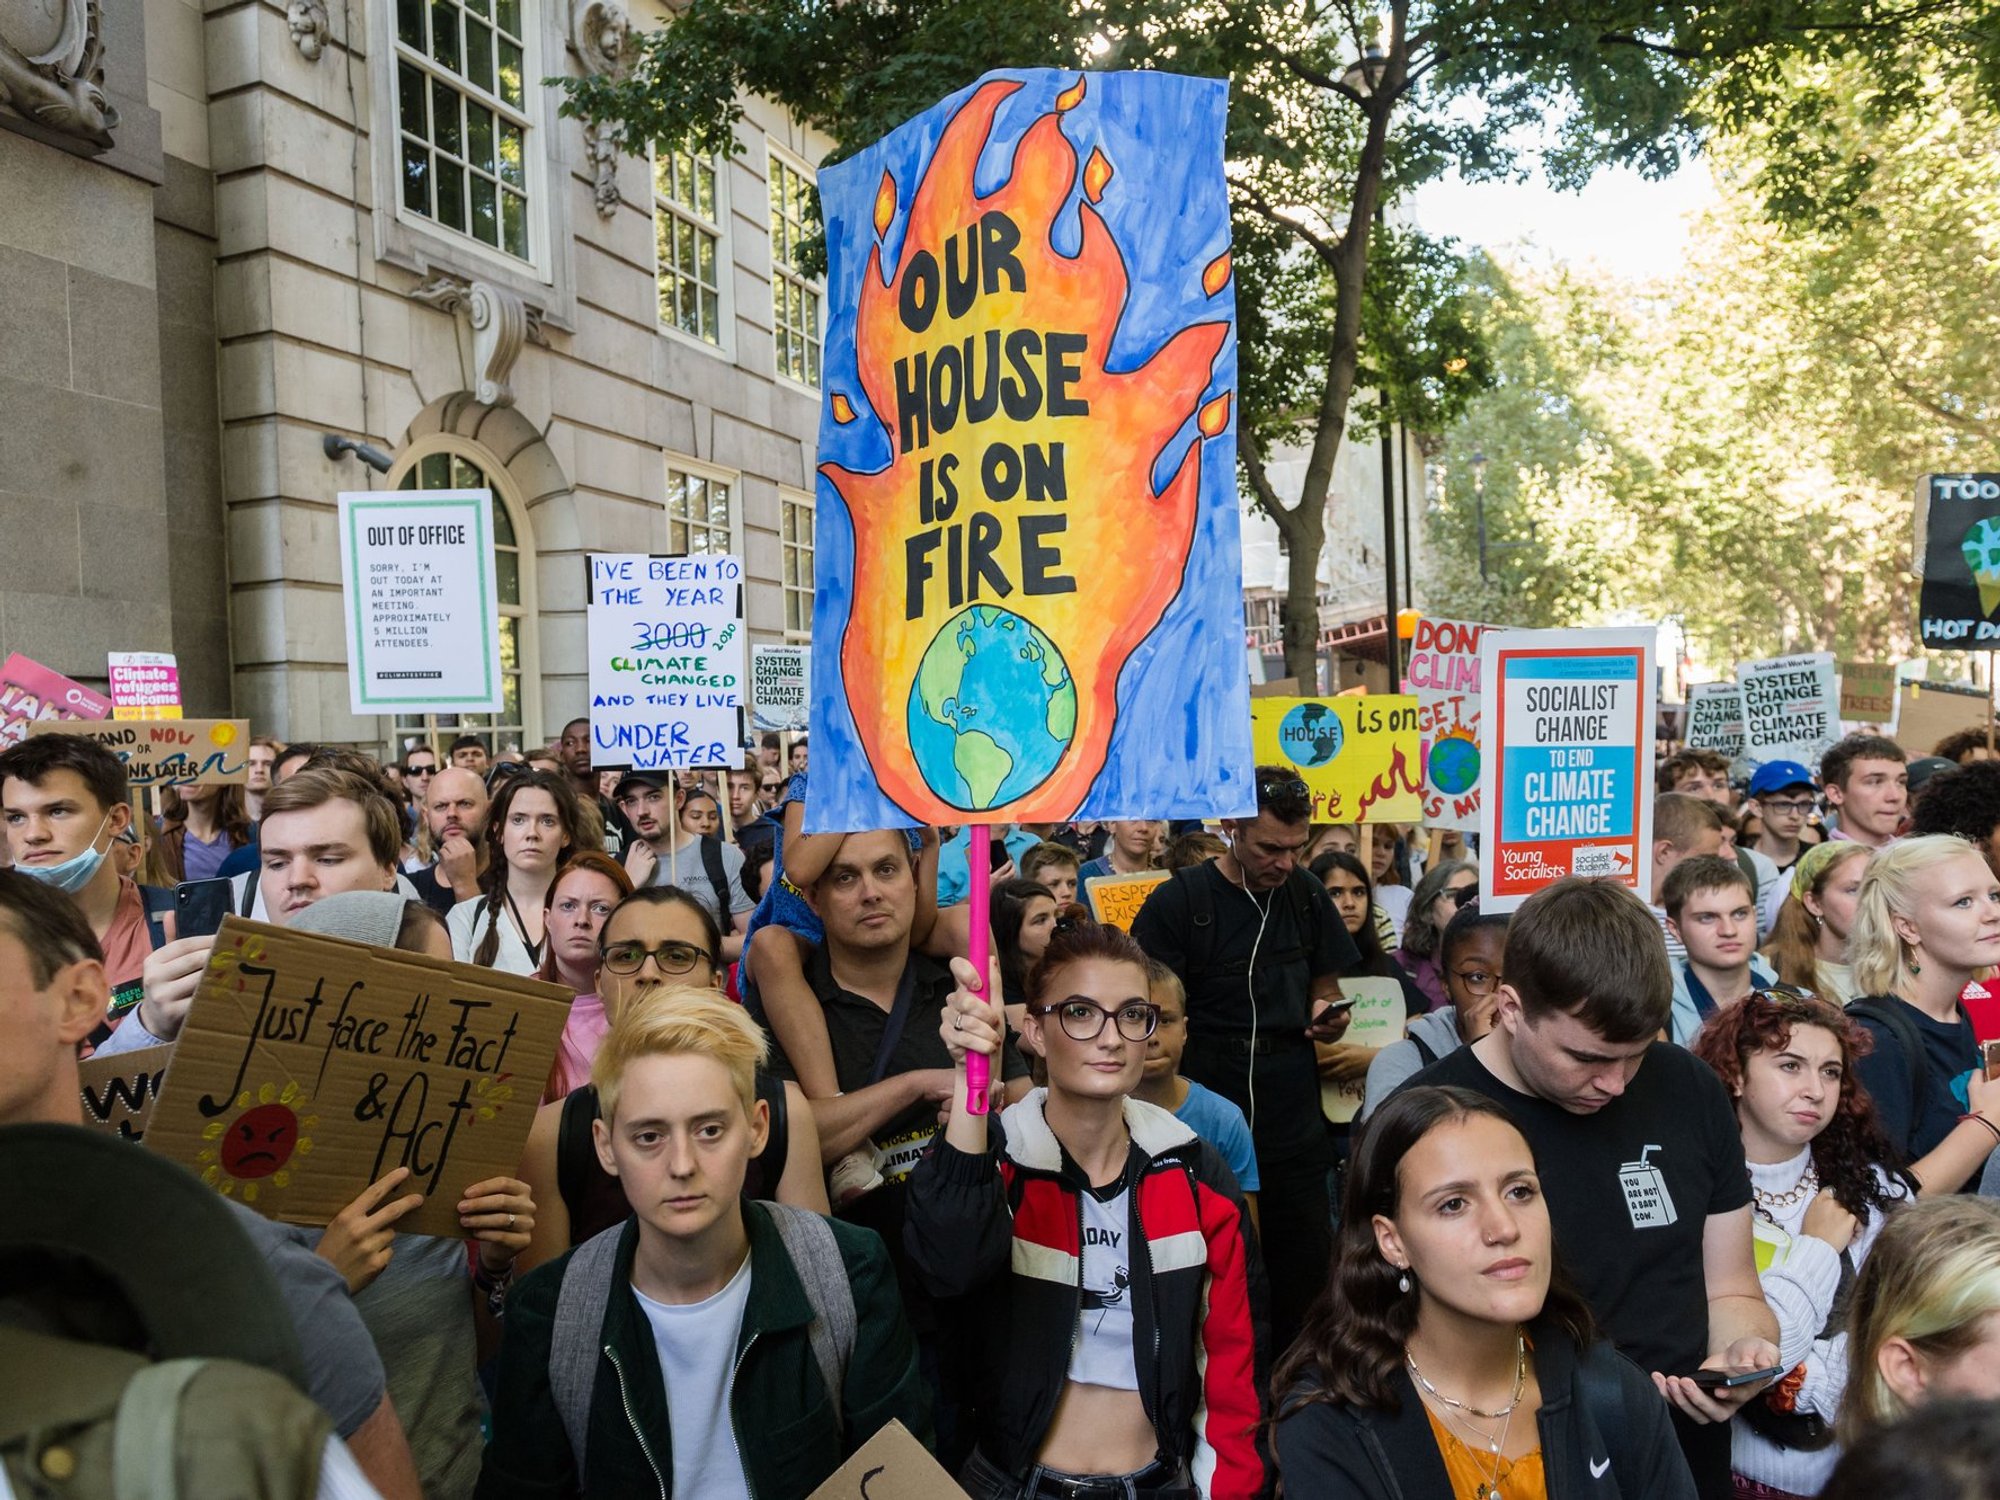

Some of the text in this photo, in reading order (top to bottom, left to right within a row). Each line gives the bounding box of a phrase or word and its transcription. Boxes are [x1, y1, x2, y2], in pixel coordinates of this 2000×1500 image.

[899, 210, 1026, 333] OUR
[894, 328, 1089, 454] HOUSE
[920, 442, 1067, 524] IS ON
[1934, 479, 2000, 499] TOO
[368, 525, 465, 546] OUT OF OFFICE
[412, 563, 431, 572] I'M
[595, 561, 739, 581] I'VE BEEN TO
[905, 512, 1077, 620] FIRE
[370, 575, 443, 585] OUT TODAY AT
[372, 588, 444, 598] AN IMPORTANT
[601, 587, 724, 607] THE YEAR
[373, 613, 451, 622] APPROXIMATELY
[374, 626, 428, 635] 5 MILLION
[631, 621, 712, 651] 3000
[1415, 619, 1482, 654] DON
[1923, 619, 1974, 639] HOT
[374, 638, 433, 648] ATTENDEES.
[610, 656, 708, 672] CLIMATE
[755, 656, 801, 666] SYSTEM
[113, 667, 168, 681] Climate
[755, 666, 803, 676] CHANGE
[1409, 653, 1481, 693] CLIM
[114, 680, 177, 695] refugees
[640, 673, 736, 688] CHANGED
[756, 676, 778, 685] NOT
[1744, 671, 1817, 691] SYSTEM
[756, 686, 804, 696] CLIMATE
[1527, 685, 1618, 712] SOCIALIST
[1746, 684, 1823, 705] CHANGE
[115, 694, 178, 706] welcome
[593, 693, 738, 708] AND THEY LIVE
[756, 696, 803, 705] CHANGE
[1695, 698, 1740, 710] SYSTE
[1419, 696, 1465, 732] GET
[1694, 710, 1741, 722] CHANG
[1748, 703, 1783, 718] NOT
[1284, 701, 1417, 742] HOUSE is on
[1536, 715, 1608, 742] CHANGE
[1692, 723, 1721, 735] NOT
[1750, 712, 1827, 732] CLIMATE
[86, 727, 195, 746] TAND NOW
[595, 721, 690, 749] UNDER
[1690, 735, 1746, 748] CLIMATE
[1751, 726, 1827, 746] CHANGE
[137, 744, 151, 754] OR
[632, 742, 726, 768] WATER
[1549, 749, 1594, 767] TO END
[128, 761, 199, 779] NK LATER
[1524, 769, 1615, 803] CLIMATE
[1312, 790, 1343, 821] re
[1526, 803, 1612, 837] CHANGE
[1502, 849, 1542, 866] Young
[1575, 853, 1608, 864] socialist
[1504, 865, 1565, 881] Socialists
[1575, 862, 1610, 872] students
[199, 964, 323, 1117] Just
[312, 981, 389, 1100] face
[395, 993, 437, 1063] the
[354, 1072, 473, 1197] & Act
[1623, 1178, 1640, 1187] YOU
[1628, 1187, 1658, 1199] ARE NOT
[1631, 1199, 1657, 1210] A BABY
[1634, 1212, 1655, 1221] COW.
[1082, 1227, 1122, 1249] DAY
